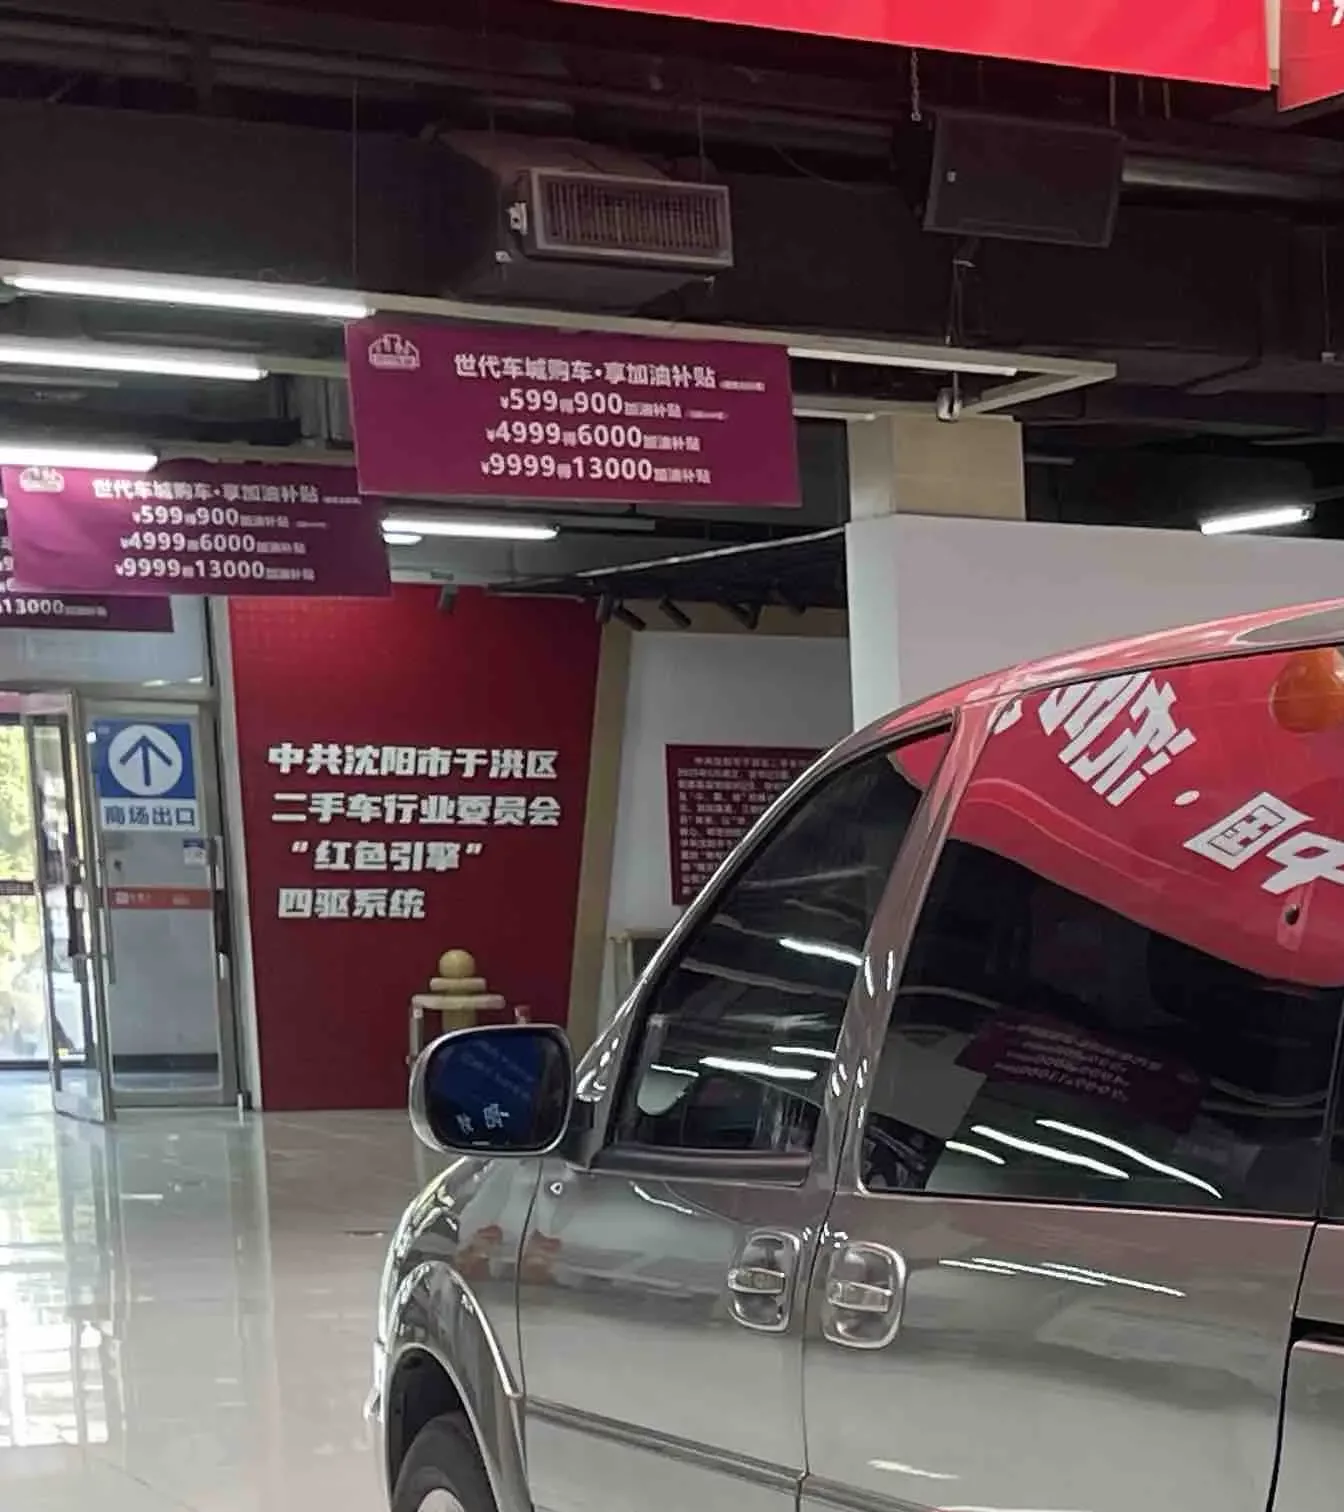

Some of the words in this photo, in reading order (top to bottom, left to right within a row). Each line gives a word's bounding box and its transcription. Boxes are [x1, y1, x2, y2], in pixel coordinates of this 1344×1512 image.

[268, 743, 558, 779] 中共沈阳市于洪区
[104, 804, 196, 826] 商场出口
[271, 792, 561, 826] 二手车行业委员会
[278, 887, 425, 919] 四驱系统
